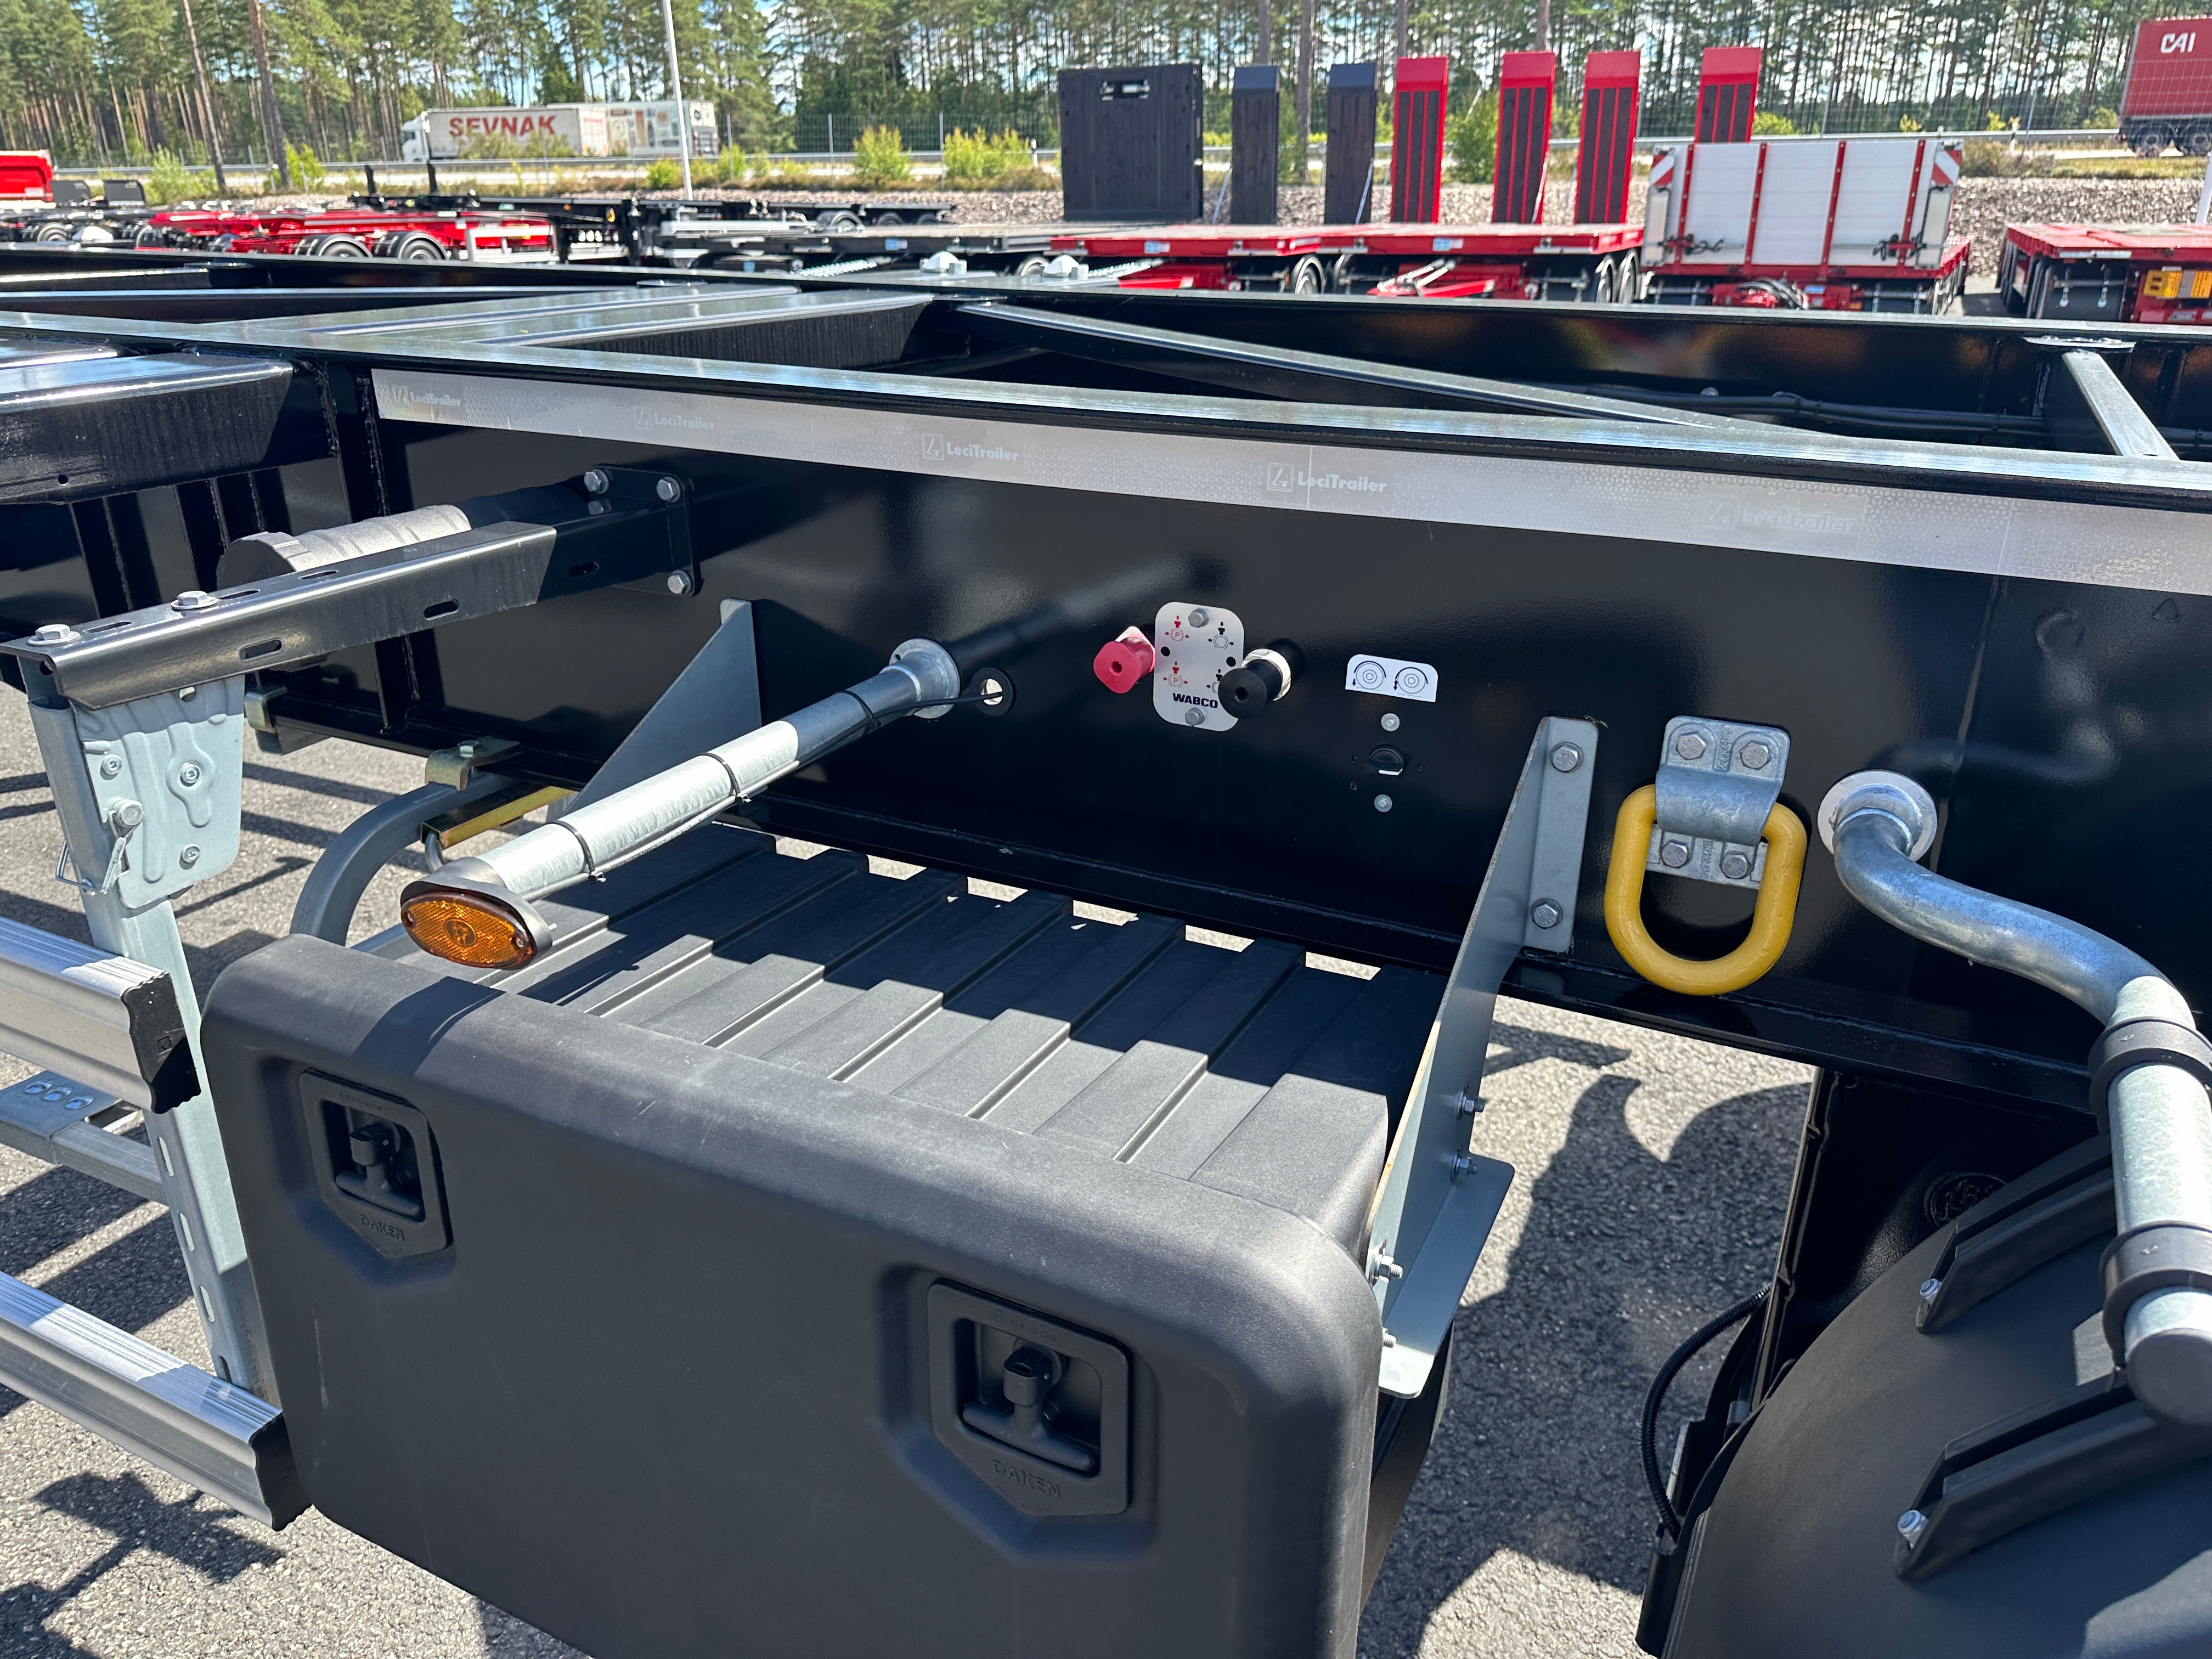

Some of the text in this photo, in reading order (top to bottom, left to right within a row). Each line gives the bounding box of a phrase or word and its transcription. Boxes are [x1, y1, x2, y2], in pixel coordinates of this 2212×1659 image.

[2160, 32, 2196, 53] CAI
[409, 391, 461, 407] LeciTrailer
[654, 412, 715, 431] LeciTrailer
[946, 441, 1019, 461] LeciTrailer
[1297, 471, 1387, 492] LeciTrailer
[1172, 693, 1218, 708] WABCO
[360, 1214, 405, 1242] DAKEN
[992, 1459, 1060, 1498] DAKEN
